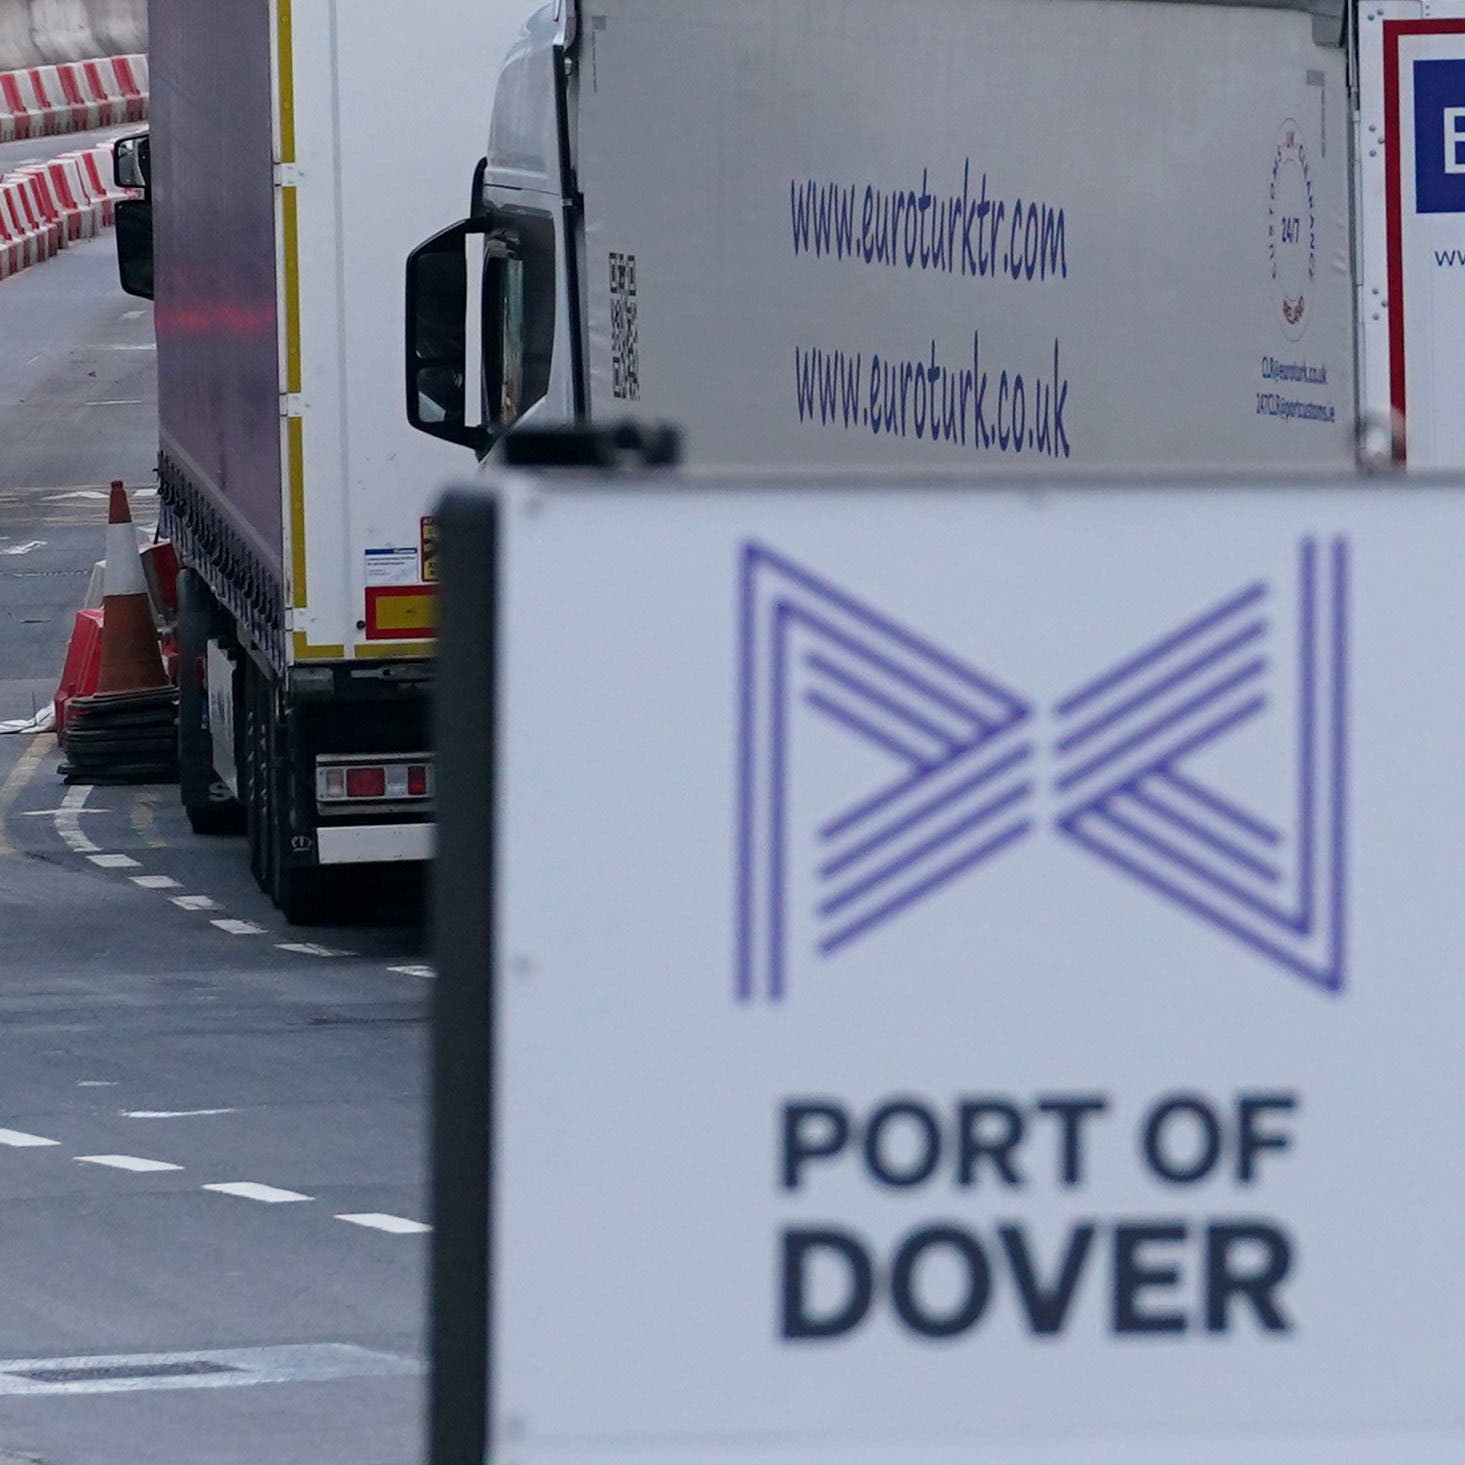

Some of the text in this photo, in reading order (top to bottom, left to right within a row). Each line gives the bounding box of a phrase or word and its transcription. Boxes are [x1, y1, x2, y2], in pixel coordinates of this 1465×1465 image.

[791, 156, 1068, 281] www.euroturktr.com
[796, 329, 1071, 459] www.euroturk.co.uk
[777, 1091, 1300, 1195] PORT OF
[776, 1217, 1299, 1346] DOVER
